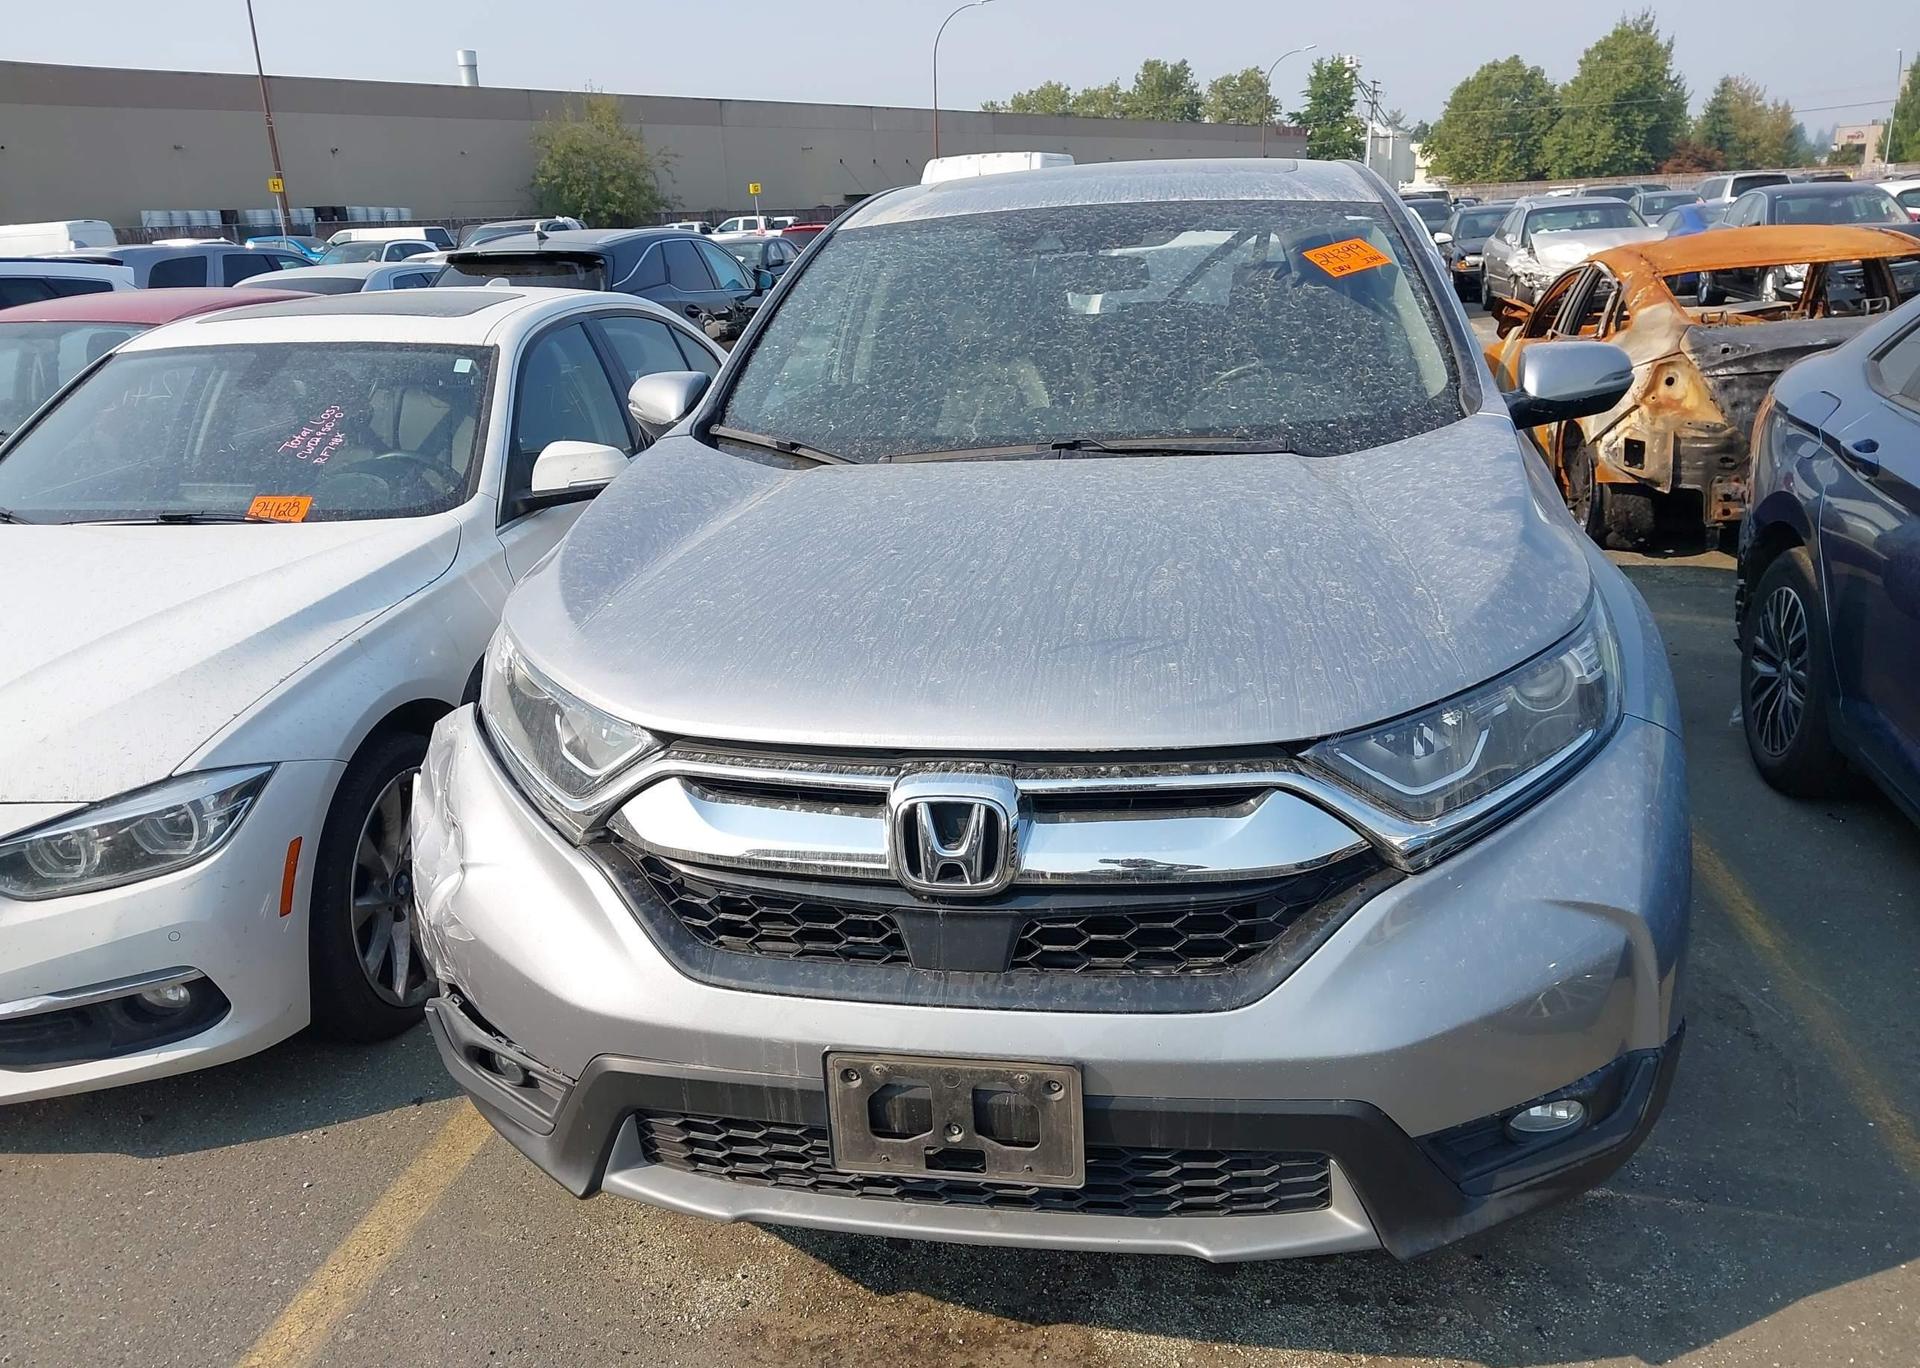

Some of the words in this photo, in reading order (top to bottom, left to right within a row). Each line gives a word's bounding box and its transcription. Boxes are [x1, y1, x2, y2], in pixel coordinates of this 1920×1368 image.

[272, 180, 280, 190] H
[1314, 243, 1368, 265] 24399
[278, 427, 313, 452] Total
[254, 501, 301, 518] 24128
